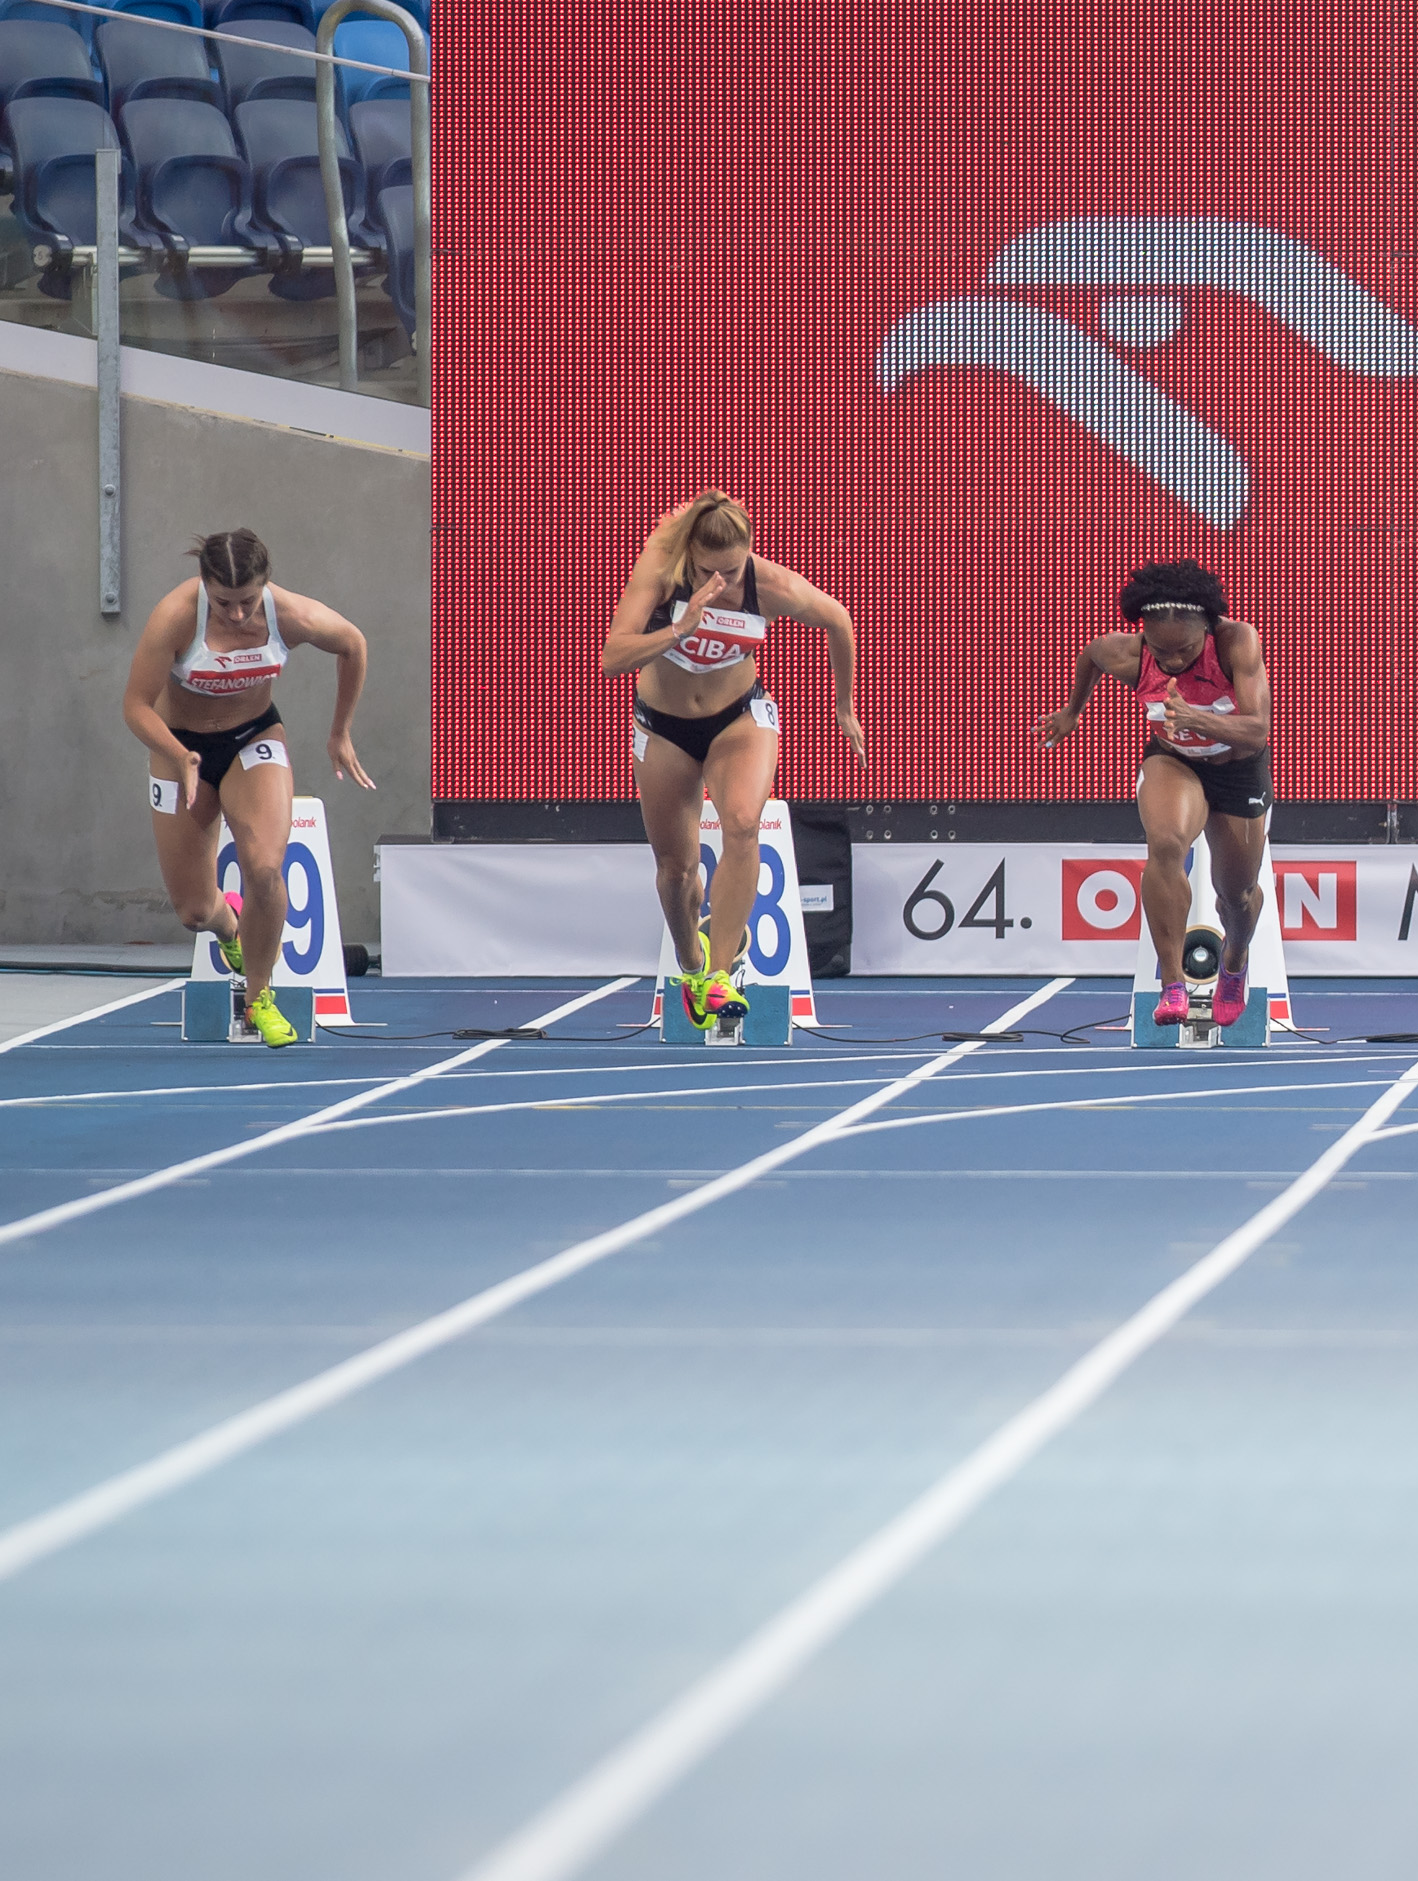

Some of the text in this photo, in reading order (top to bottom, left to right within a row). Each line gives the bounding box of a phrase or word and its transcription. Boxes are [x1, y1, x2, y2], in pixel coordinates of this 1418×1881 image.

[717, 617, 745, 628] ORLEN
[234, 654, 261, 663] ORLEN
[679, 636, 741, 660] CIBA
[764, 703, 775, 726] 8
[255, 743, 272, 760] 9
[152, 783, 162, 806] 9
[280, 842, 325, 976] 9
[746, 844, 792, 977] 8
[903, 857, 1033, 941] 64.
